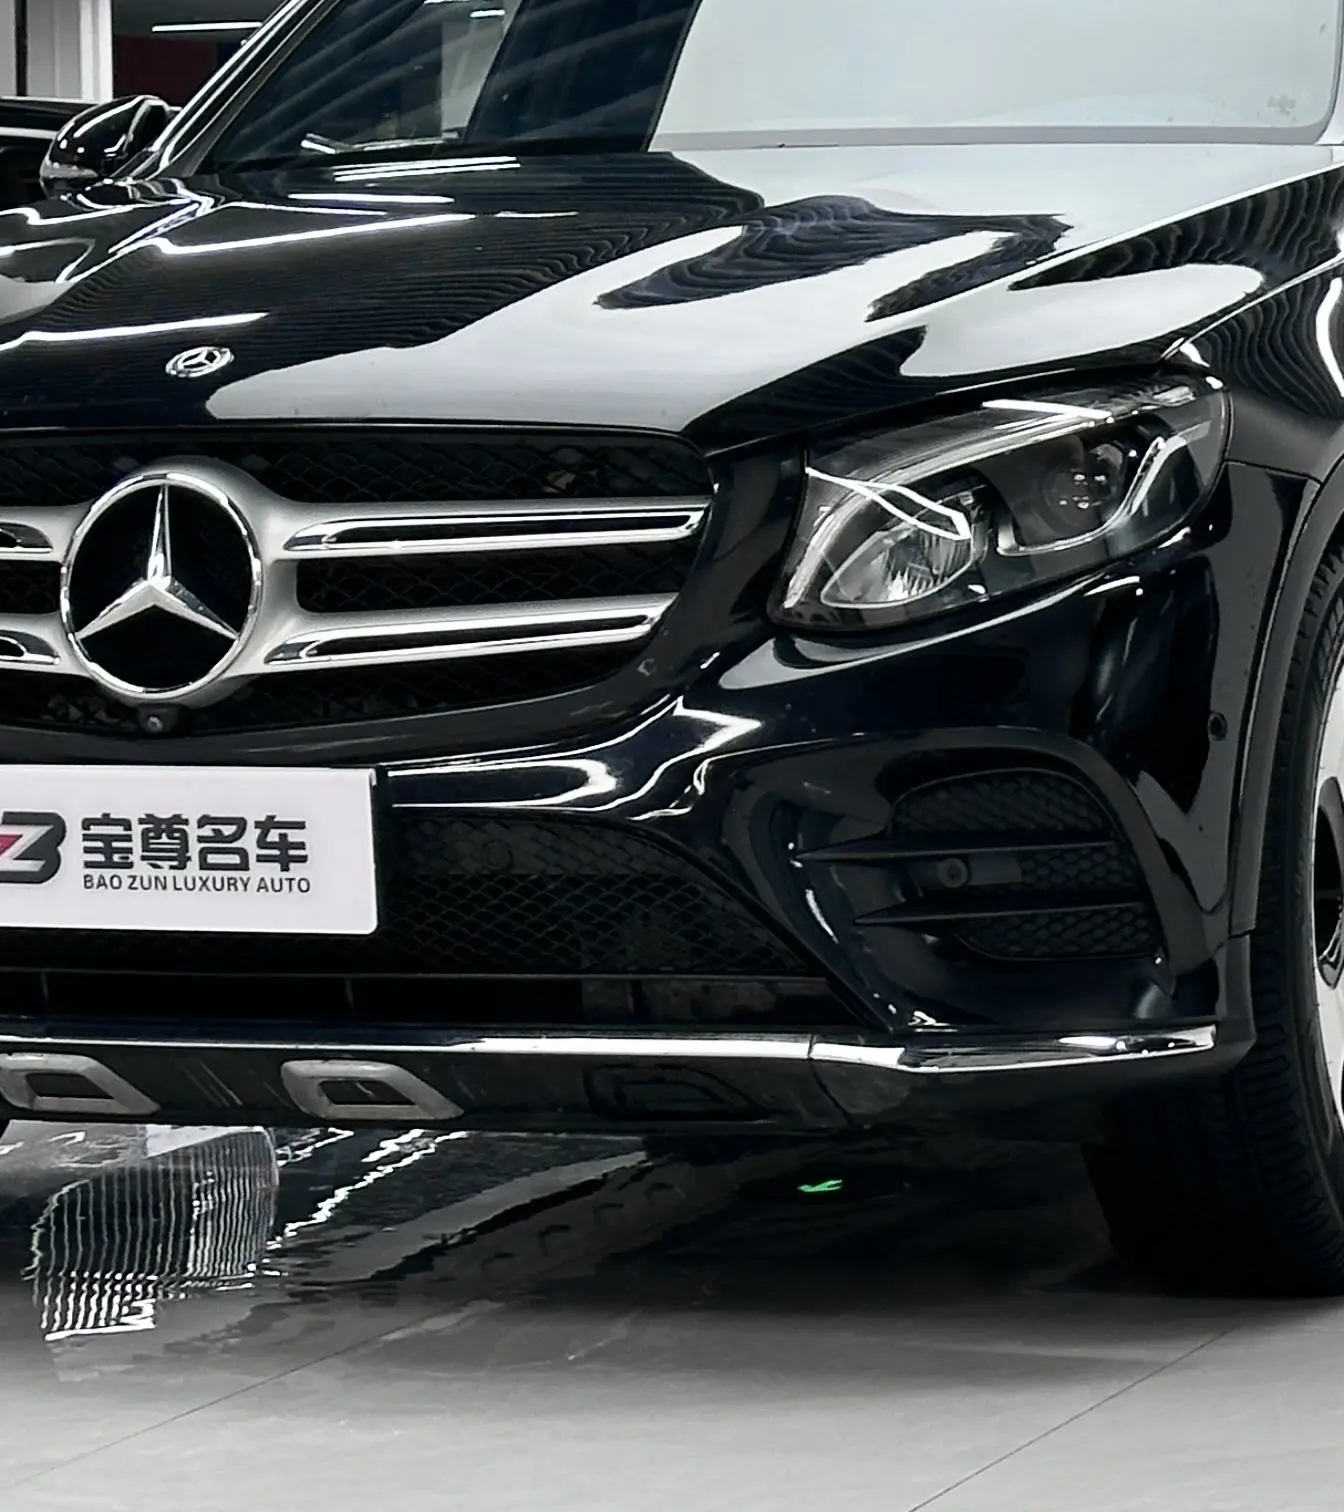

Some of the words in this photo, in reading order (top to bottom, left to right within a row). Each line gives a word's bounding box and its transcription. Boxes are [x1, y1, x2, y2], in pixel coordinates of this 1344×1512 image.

[81, 812, 309, 872] 宝尊名车
[83, 874, 123, 890] BAO
[127, 875, 168, 891] ZUN
[172, 875, 251, 892] LUXURY
[255, 876, 311, 893] AUTO
